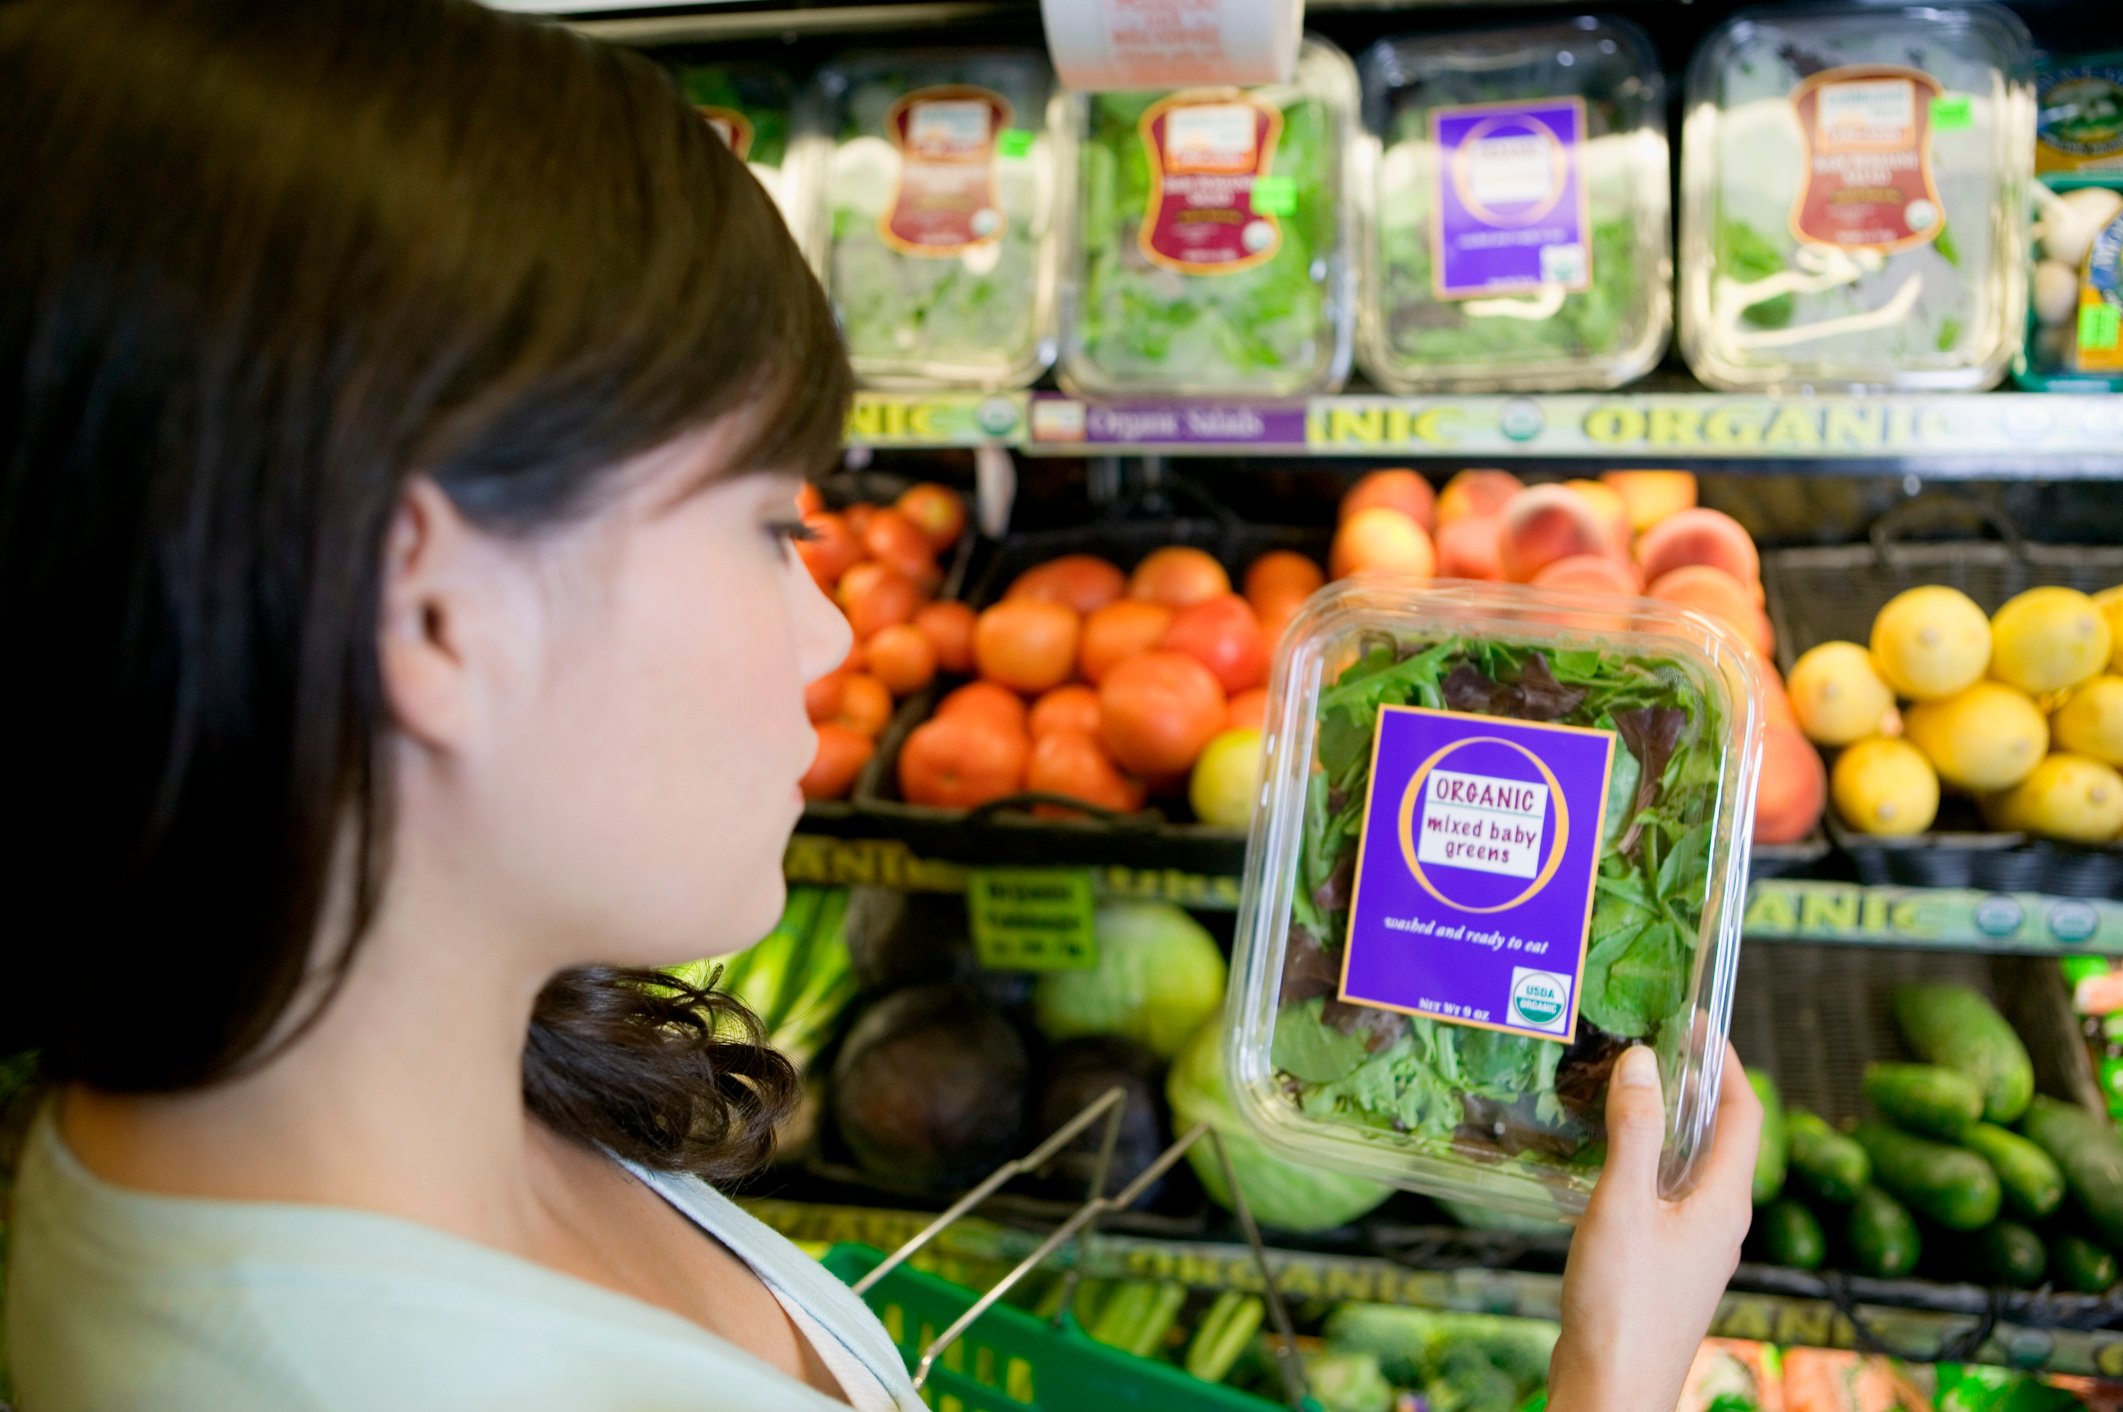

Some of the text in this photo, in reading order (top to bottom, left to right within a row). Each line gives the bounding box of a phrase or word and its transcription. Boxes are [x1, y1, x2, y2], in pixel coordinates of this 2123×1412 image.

[1090, 404, 1179, 442] Organic
[1583, 402, 1958, 450] ORGANIC
[1436, 778, 1534, 812] ORGANIC
[1427, 814, 1537, 849] mixed baby
[1445, 841, 1510, 863] greens
[1384, 916, 1549, 955] washed and ready to eat
[1519, 998, 1558, 1015] ORGANIC
[1526, 984, 1555, 999] USDA
[1463, 1005, 1470, 1017] 9
